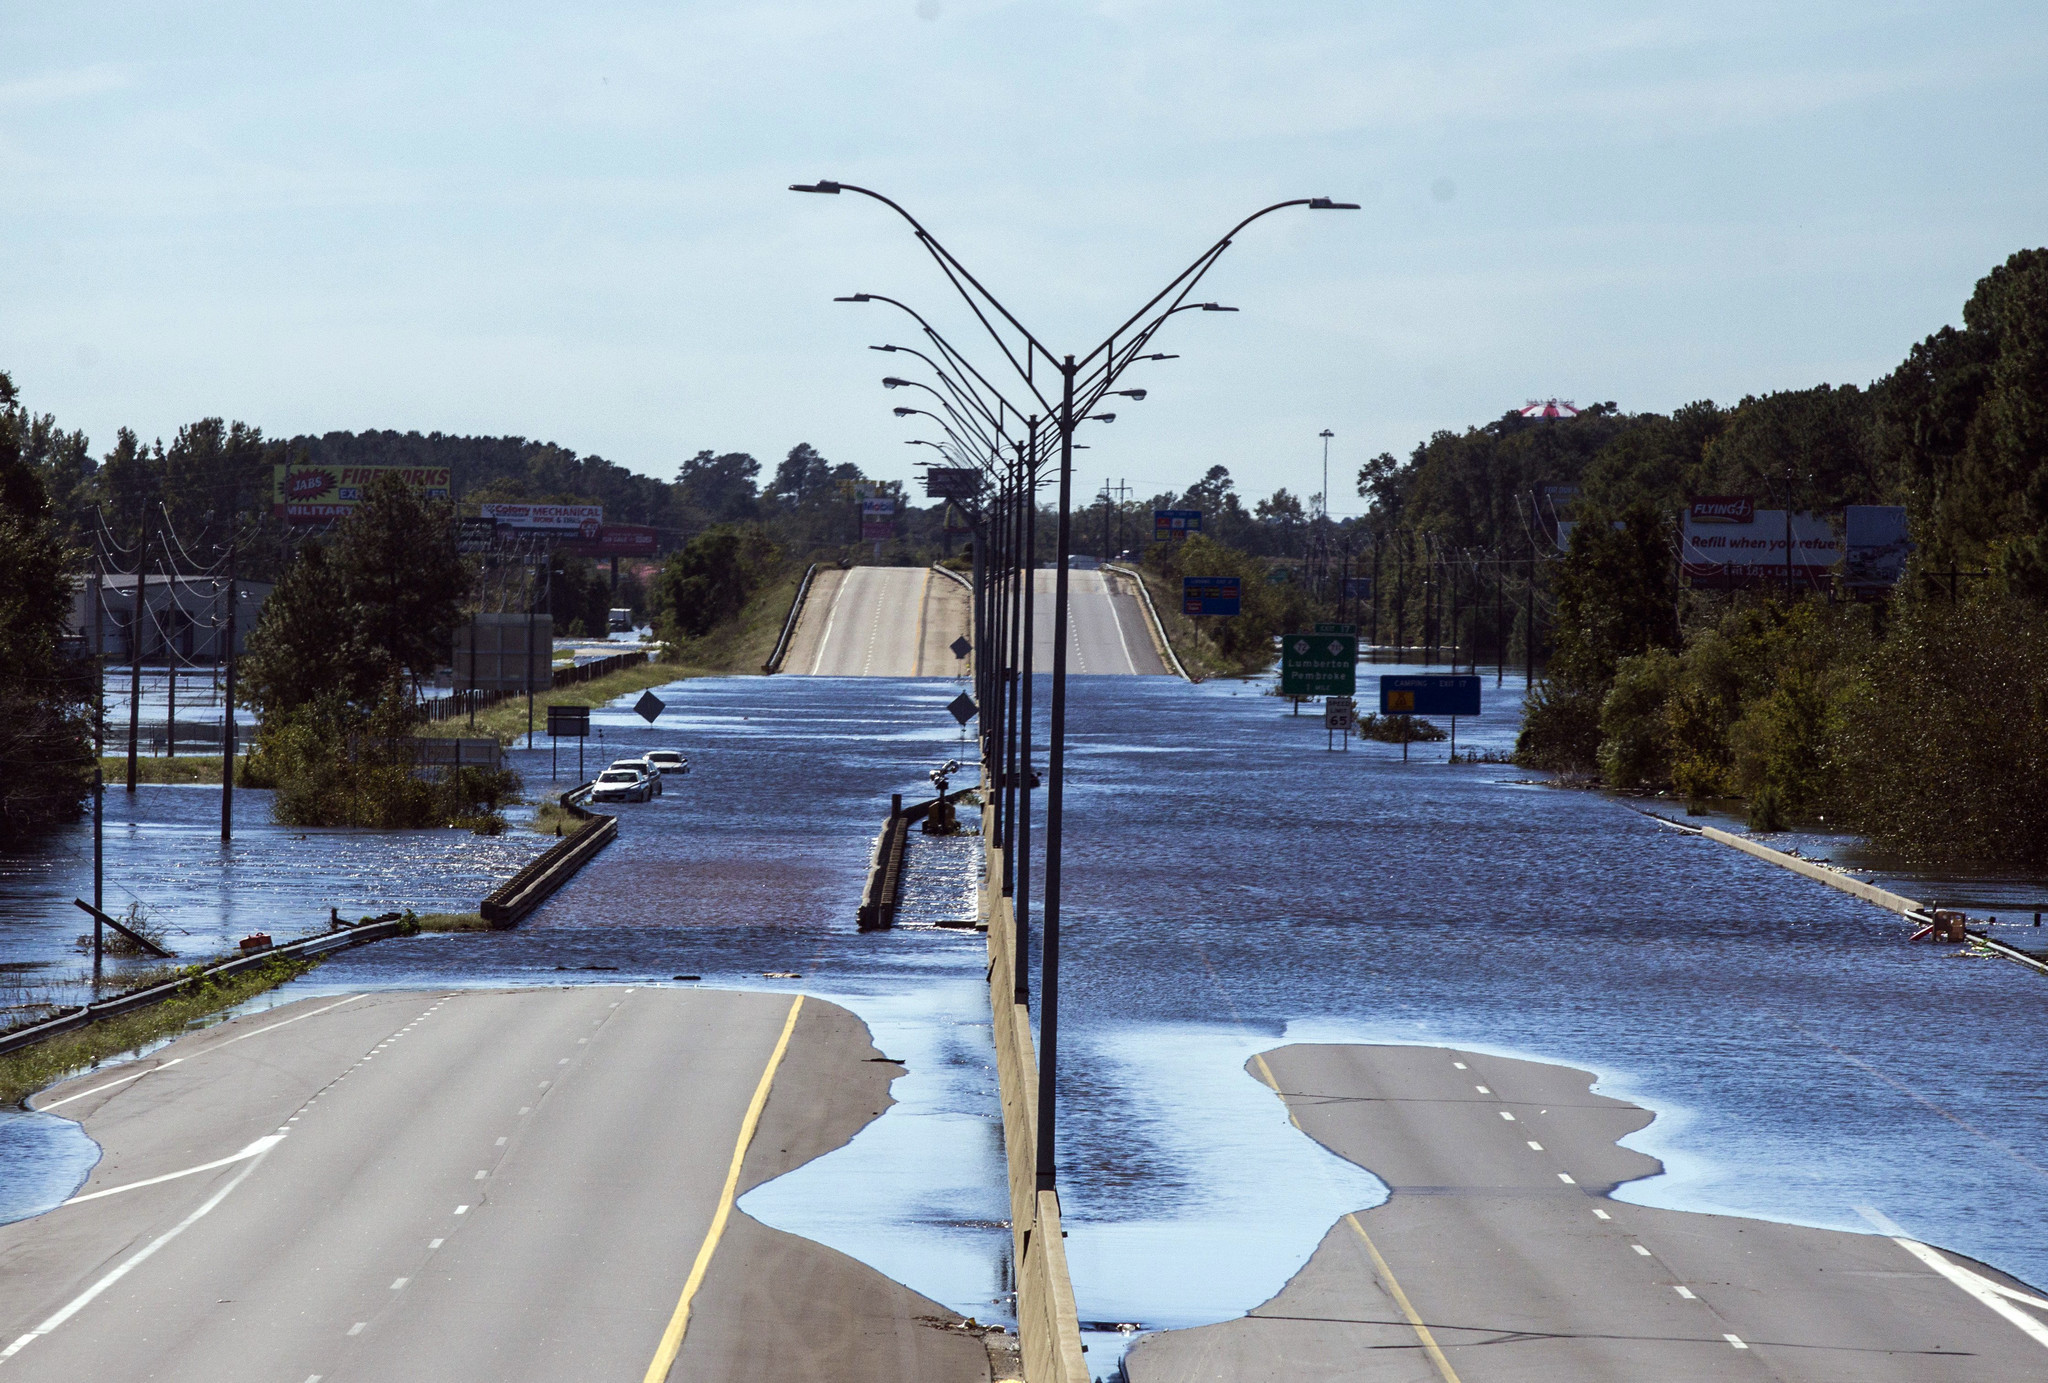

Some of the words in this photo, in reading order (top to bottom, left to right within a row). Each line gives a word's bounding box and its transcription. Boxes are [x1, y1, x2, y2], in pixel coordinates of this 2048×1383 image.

[341, 468, 450, 486] FIREORKS
[293, 477, 323, 491] JABS
[495, 505, 531, 516] Colony
[533, 507, 600, 517] MECHANICAL
[864, 502, 894, 511] Mobil
[1694, 503, 1736, 515] FLYING
[1691, 536, 1726, 549] Refill
[1730, 537, 1767, 549] when
[1341, 625, 1351, 633] 17
[1288, 660, 1349, 668] Lumberton
[1291, 671, 1346, 680] Pembroke
[1394, 679, 1428, 687] CAMPING
[1459, 680, 1468, 688] 17
[1330, 716, 1347, 726] 65
